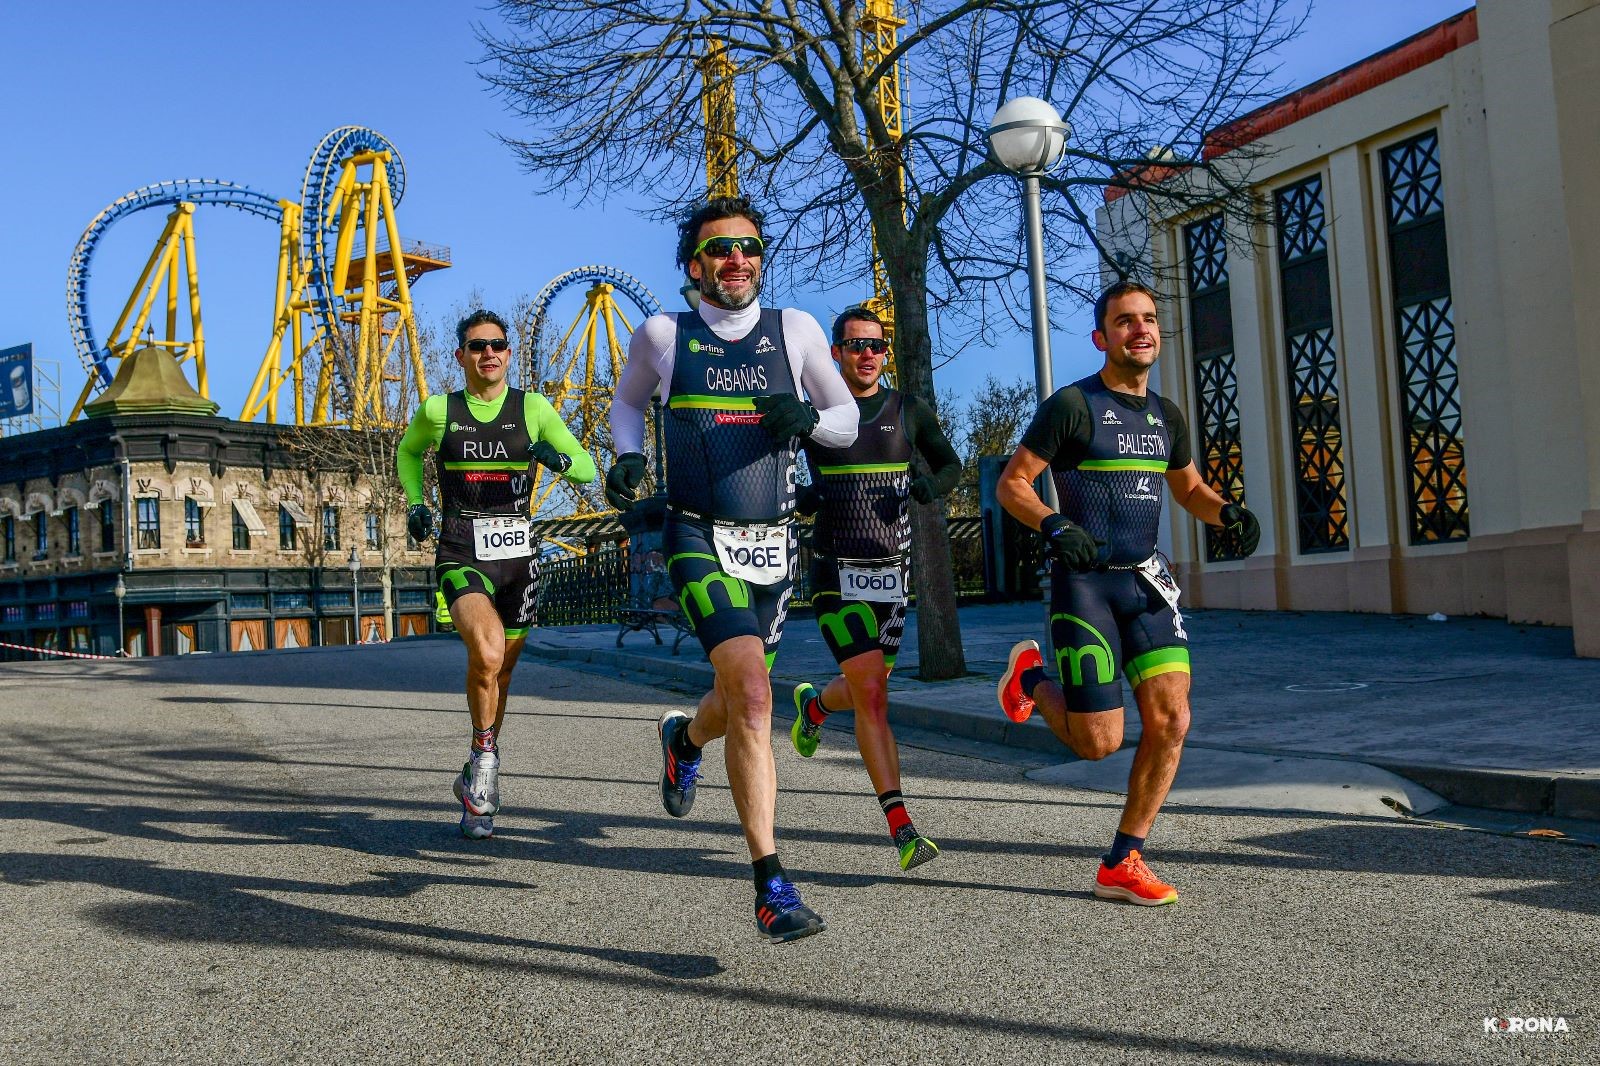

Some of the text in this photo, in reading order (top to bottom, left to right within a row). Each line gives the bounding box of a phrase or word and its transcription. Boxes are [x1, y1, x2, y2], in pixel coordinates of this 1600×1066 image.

[706, 363, 768, 391] CABAÑAS
[463, 440, 509, 459] RUA
[483, 530, 525, 549] 106B
[725, 546, 782, 568] 106E
[847, 573, 897, 591] 106D
